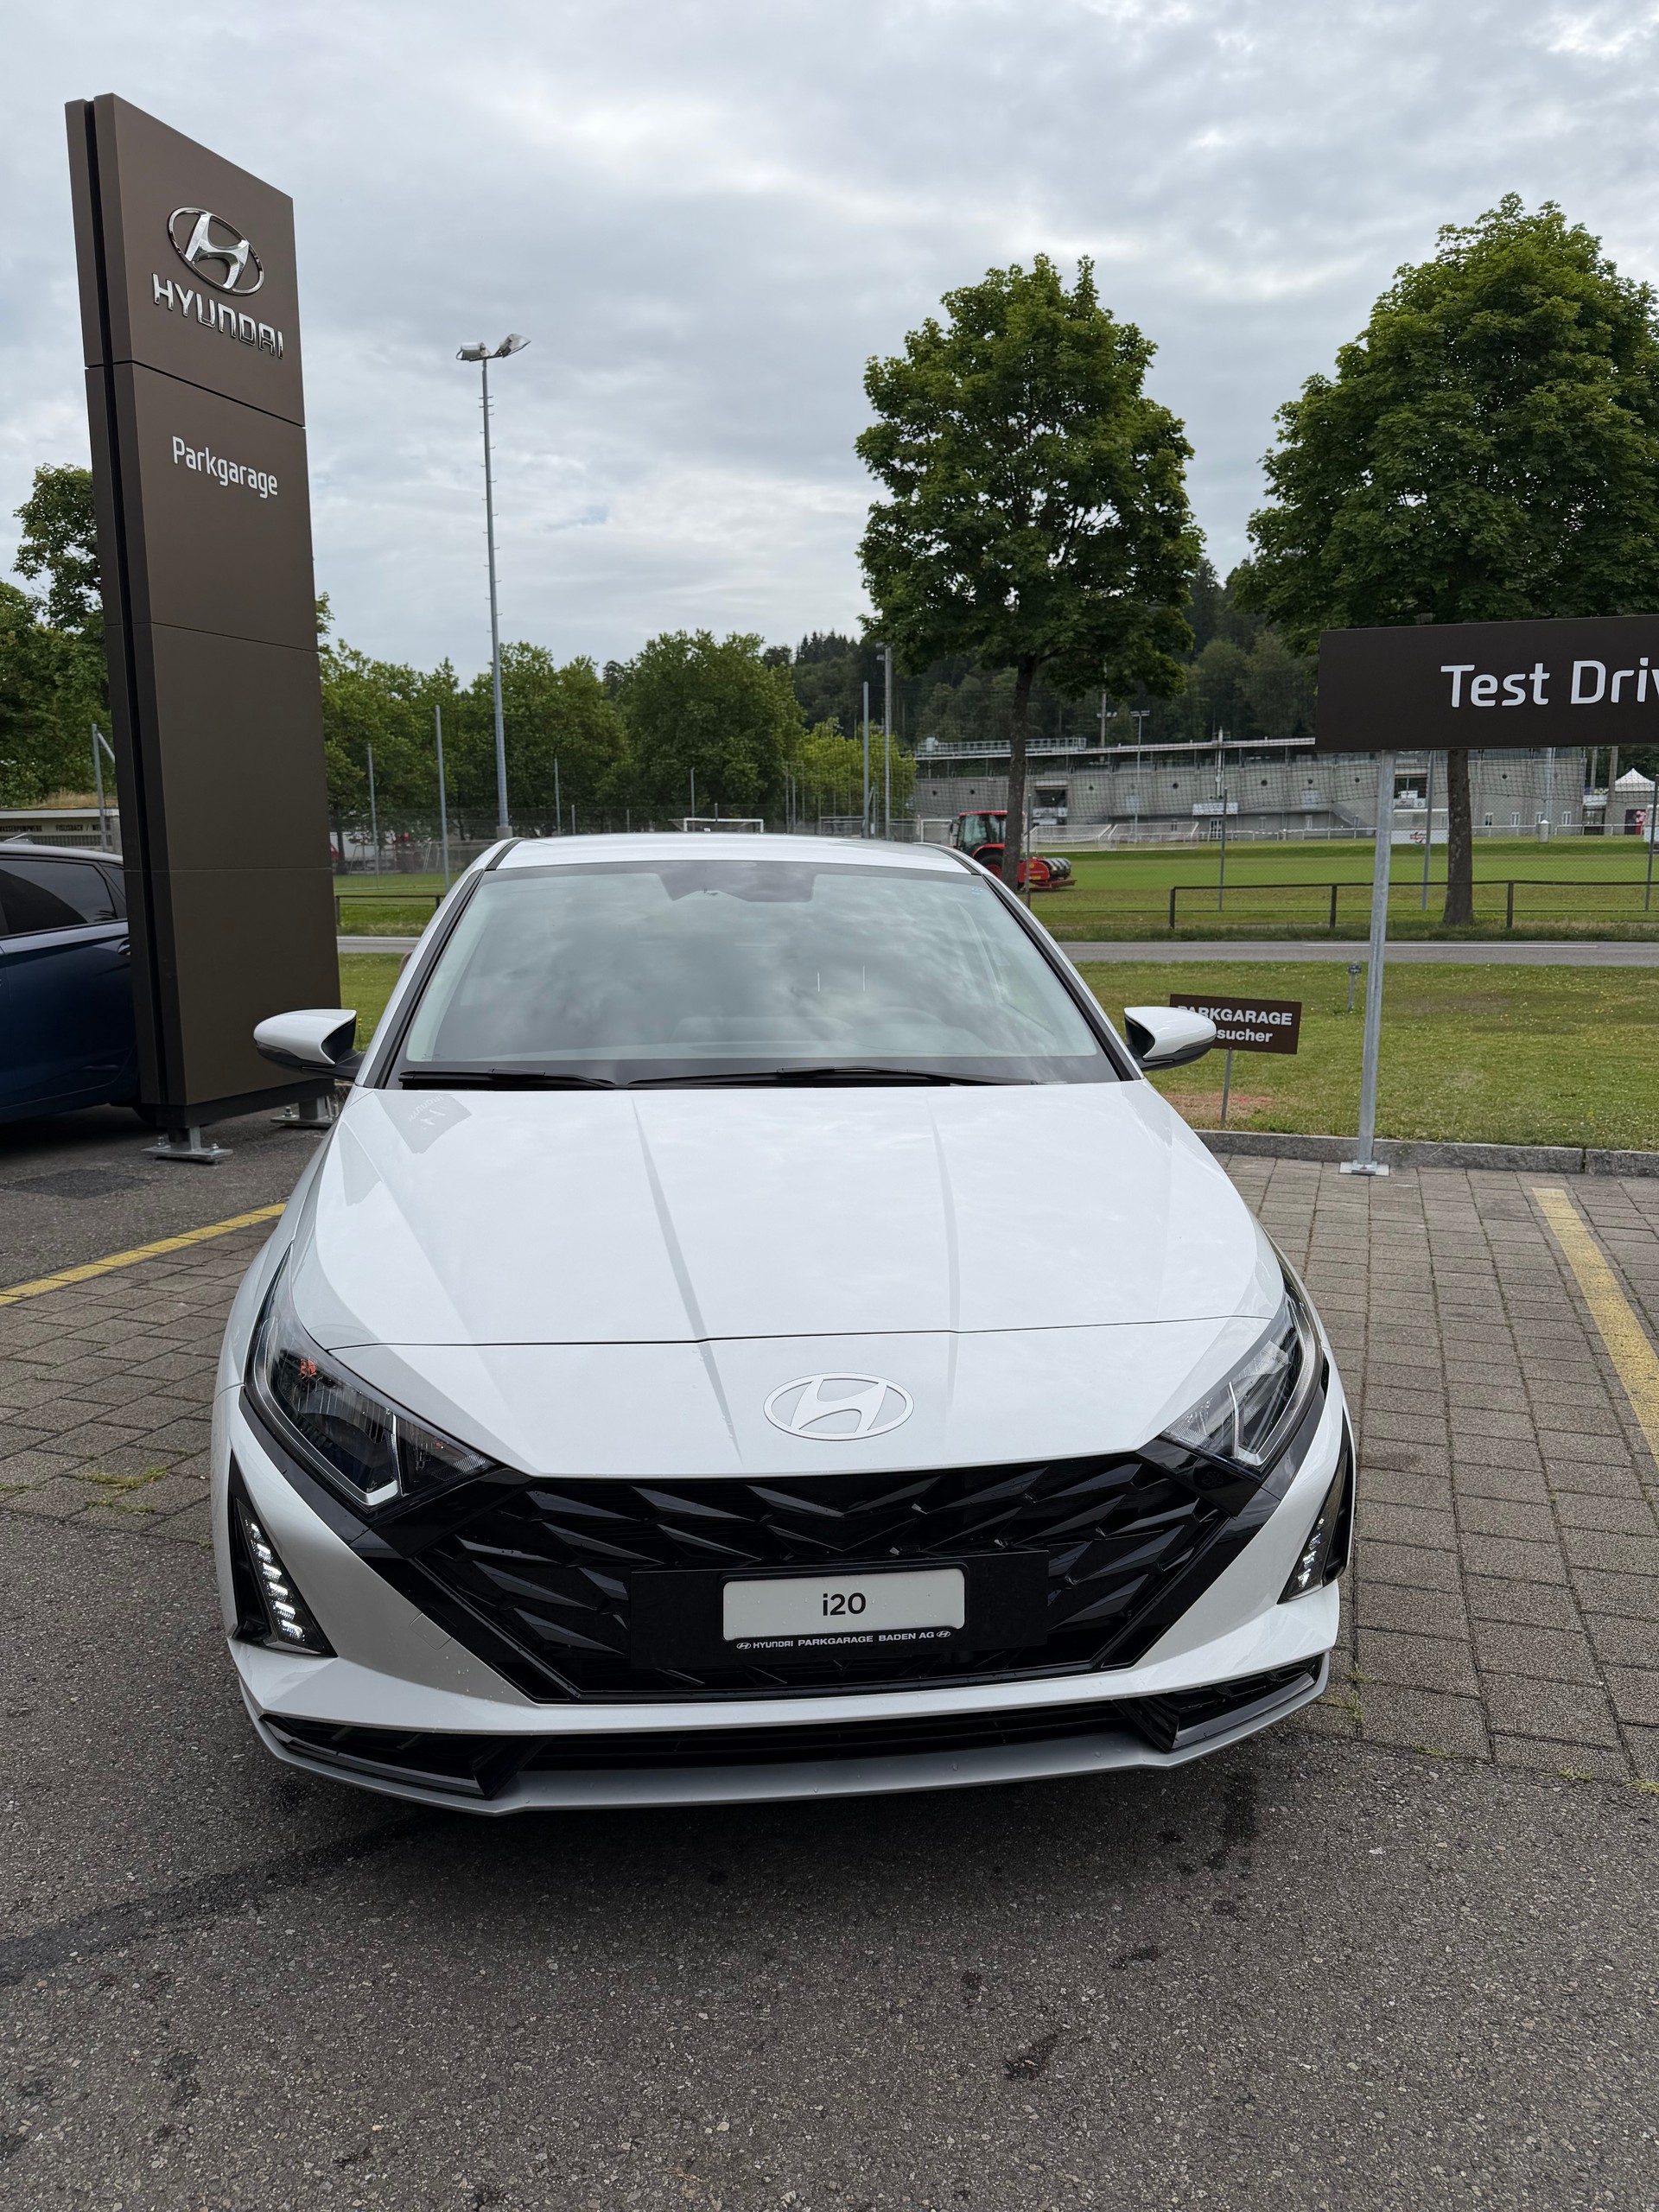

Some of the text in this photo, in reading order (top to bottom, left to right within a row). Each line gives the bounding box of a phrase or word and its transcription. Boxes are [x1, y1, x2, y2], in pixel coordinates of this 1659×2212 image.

[152, 273, 284, 359] HYUNDAI
[172, 435, 279, 499] Parkgarage
[1440, 663, 1551, 709] Test
[1178, 1006, 1293, 1026] RKGARAGE
[1217, 1028, 1273, 1042] sucher
[822, 1592, 867, 1617] i20
[753, 1630, 935, 1649] HYUNDAI PARKGARAGE BADEN AG
